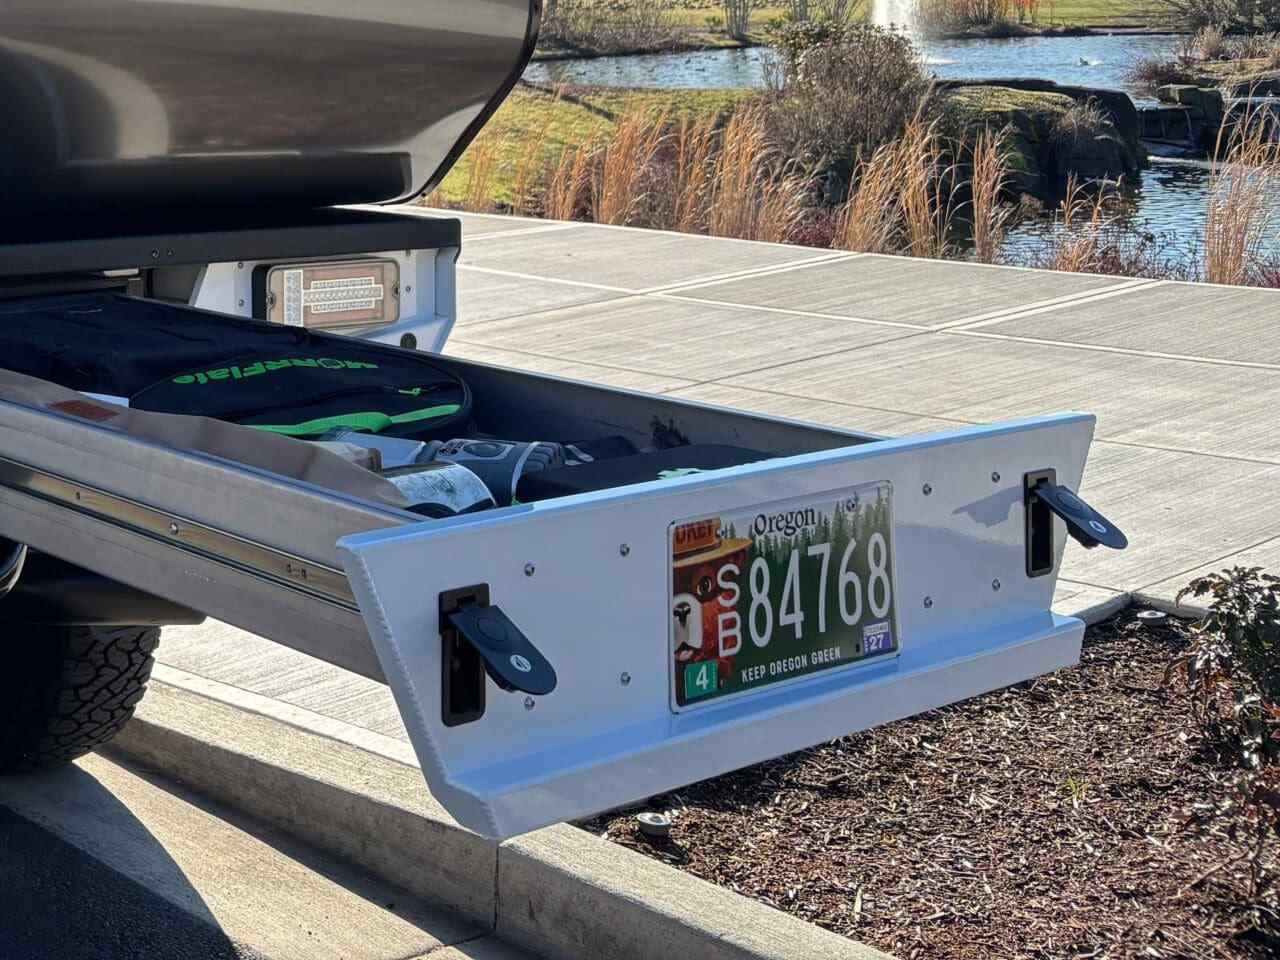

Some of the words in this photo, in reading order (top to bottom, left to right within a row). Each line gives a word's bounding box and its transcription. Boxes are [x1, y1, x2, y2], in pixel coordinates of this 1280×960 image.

[754, 507, 817, 537] Oregon
[748, 532, 891, 648] 84768
[869, 634, 884, 650] 27
[695, 663, 709, 690] 4
[741, 665, 766, 683] KEEP
[769, 657, 808, 679] OREGON
[812, 646, 841, 668] GREEN
